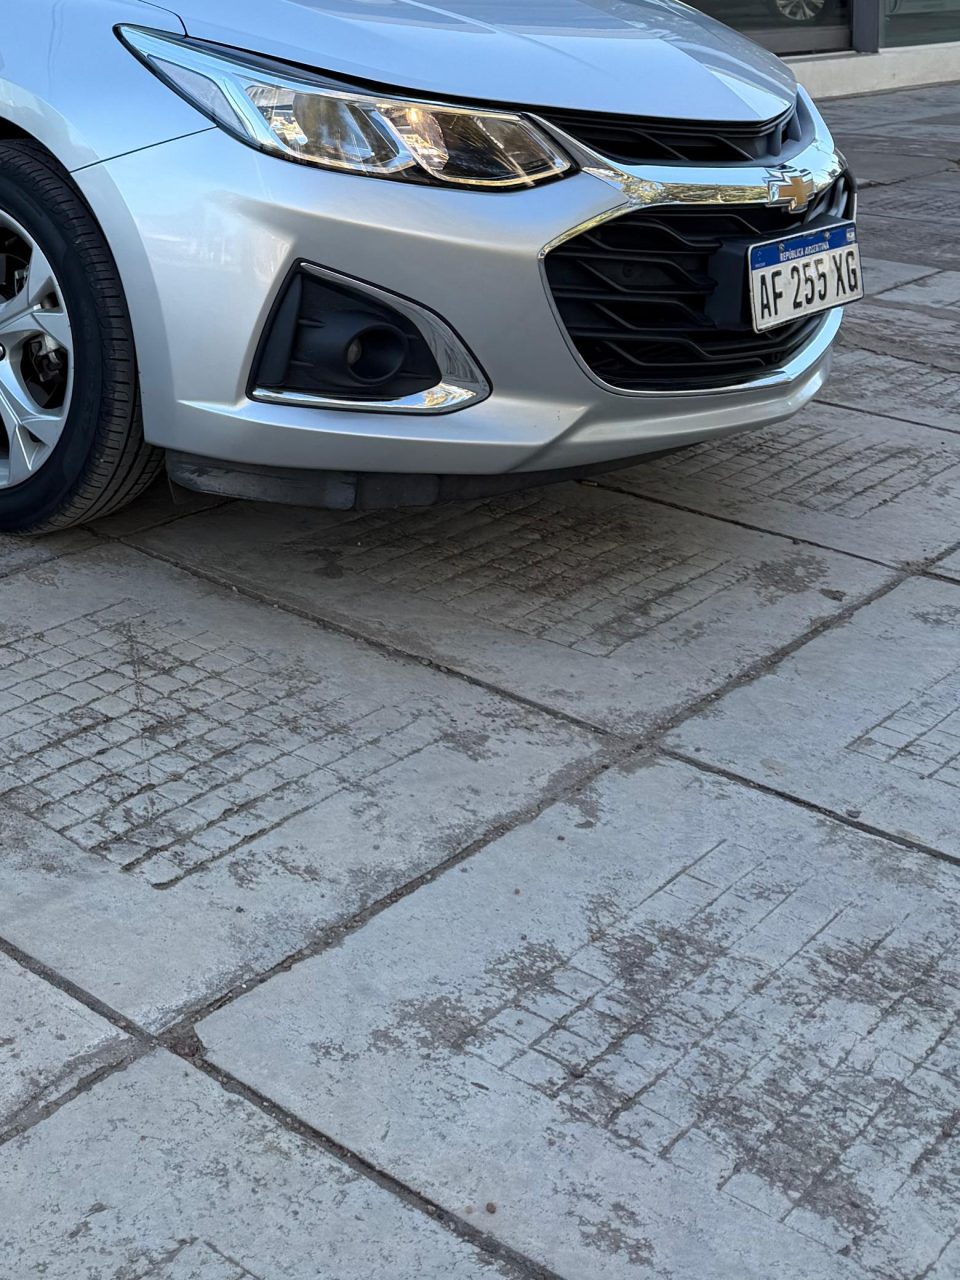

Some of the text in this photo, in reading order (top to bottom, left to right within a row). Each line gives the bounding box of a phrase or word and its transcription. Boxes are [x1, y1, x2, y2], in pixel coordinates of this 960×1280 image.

[804, 241, 830, 256] ARGENTINA
[760, 250, 858, 319] AF 255 XG
